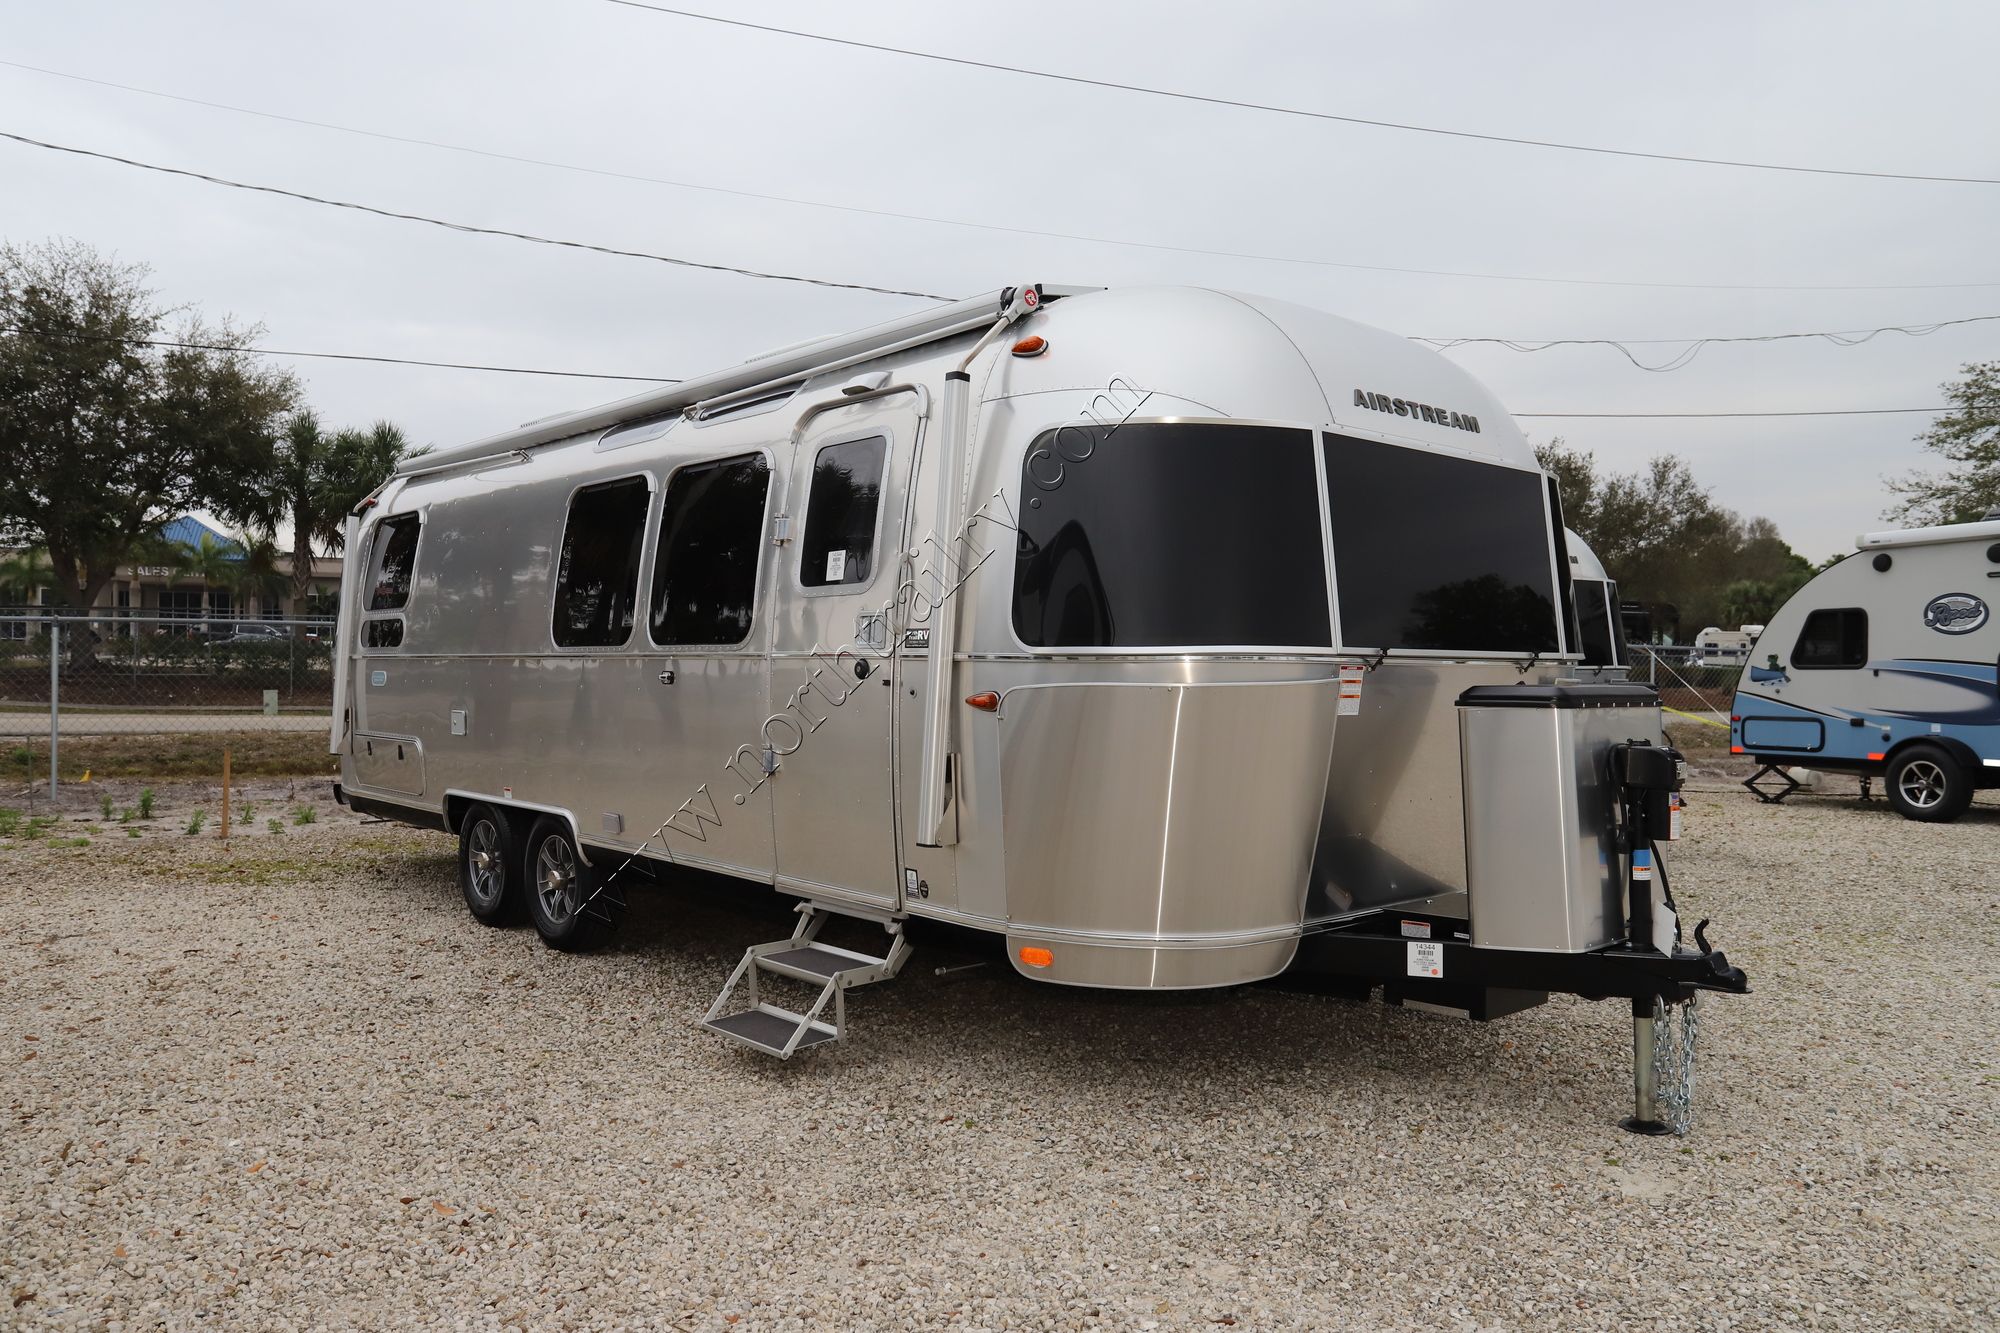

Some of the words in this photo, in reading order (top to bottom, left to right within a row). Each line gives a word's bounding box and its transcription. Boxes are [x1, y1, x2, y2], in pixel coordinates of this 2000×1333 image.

[1353, 388, 1481, 433] AIRSTREAM
[127, 566, 169, 576] SALES
[1415, 943, 1436, 951] 14344
